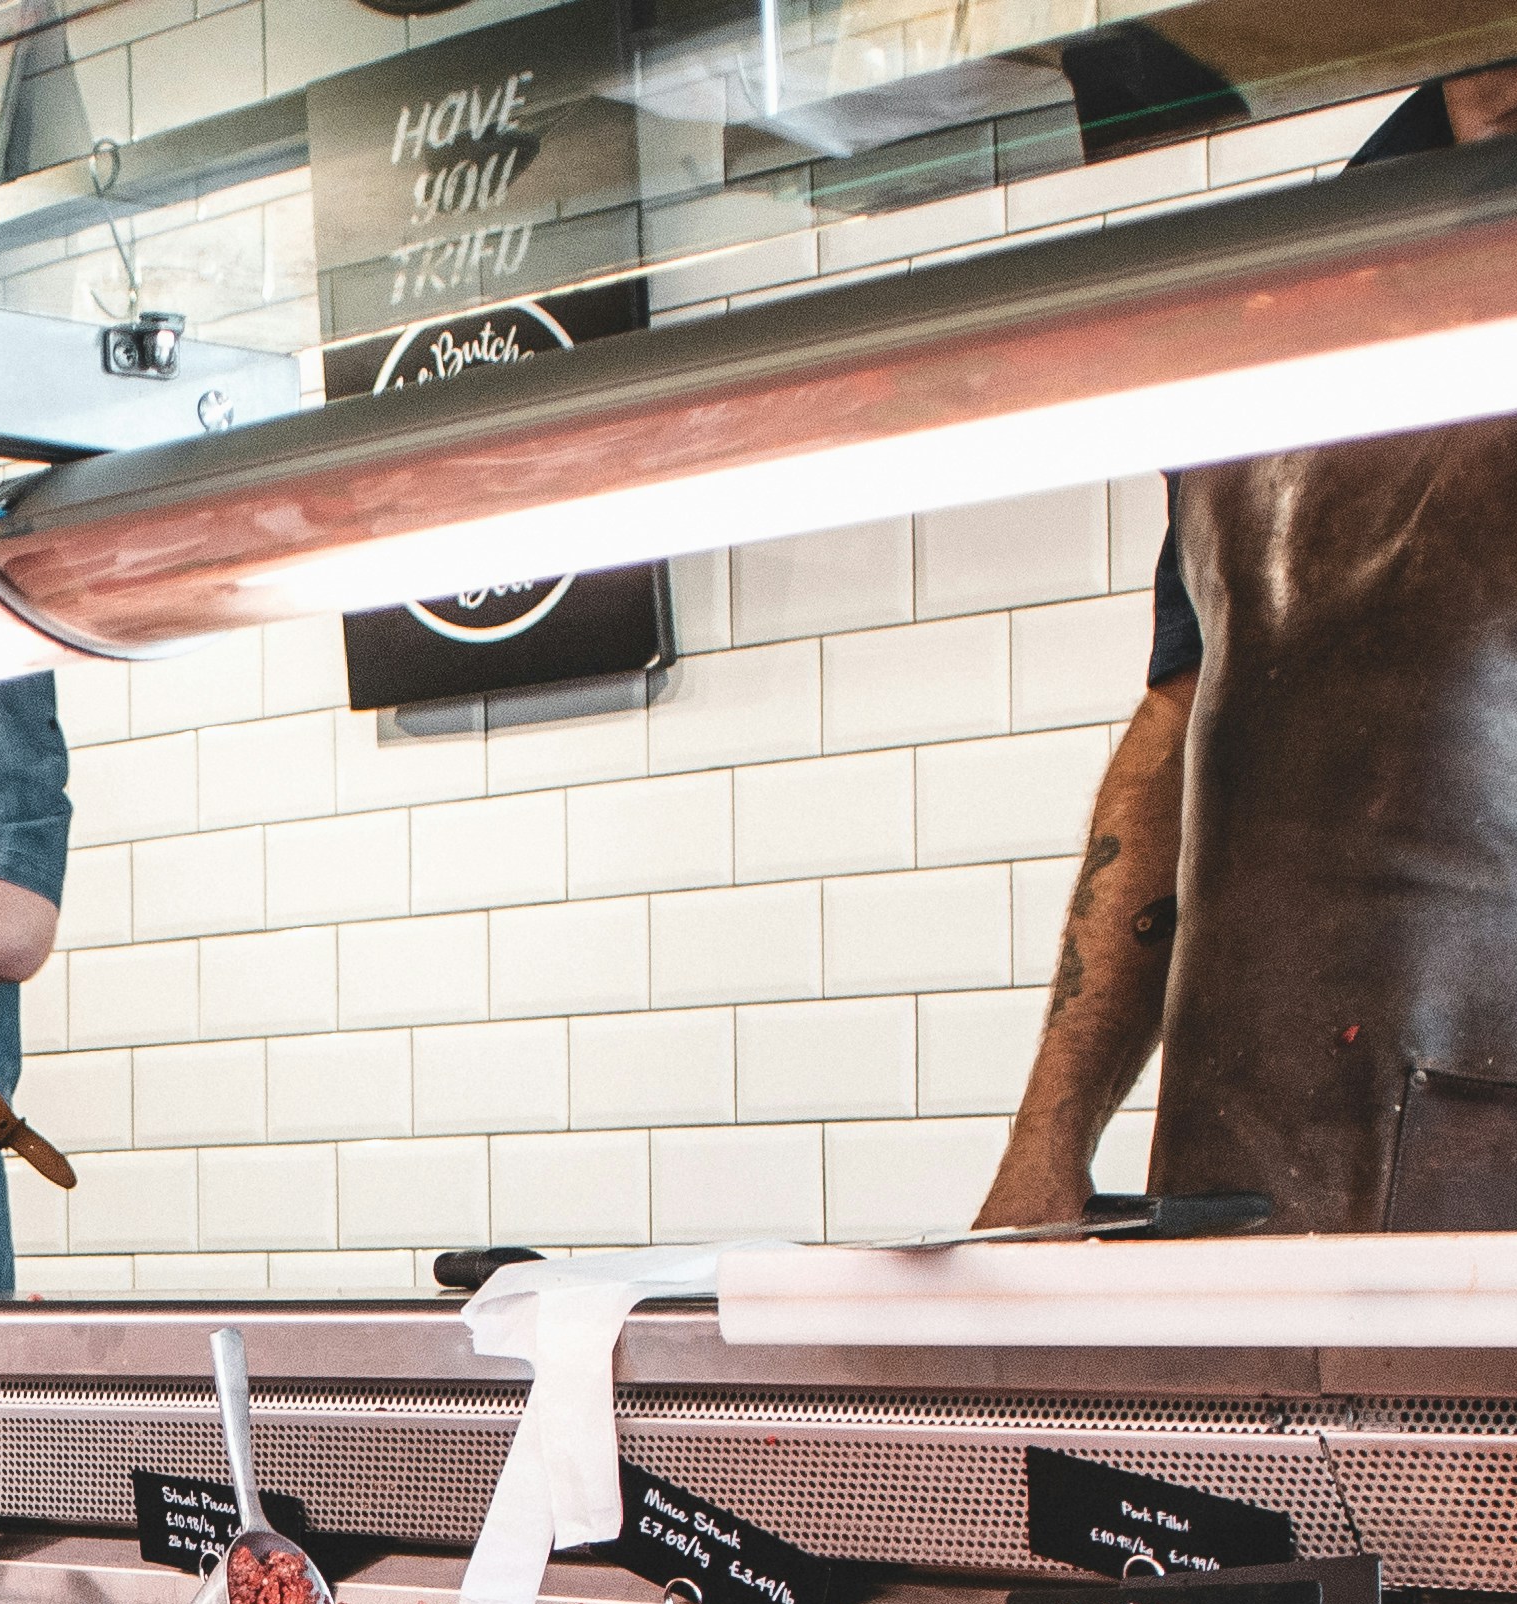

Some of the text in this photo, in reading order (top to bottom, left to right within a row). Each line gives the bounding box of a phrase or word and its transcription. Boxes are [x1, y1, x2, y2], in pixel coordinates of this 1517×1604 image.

[391, 70, 534, 165] HAVE
[162, 1485, 237, 1515] Steak Pieces
[1120, 1500, 1192, 1533] Pork Fillet
[166, 1511, 216, 1539] £10.98/kg
[644, 1487, 742, 1551] Mince Steak
[184, 1536, 197, 1551] for
[639, 1515, 712, 1569] £7.68/kg
